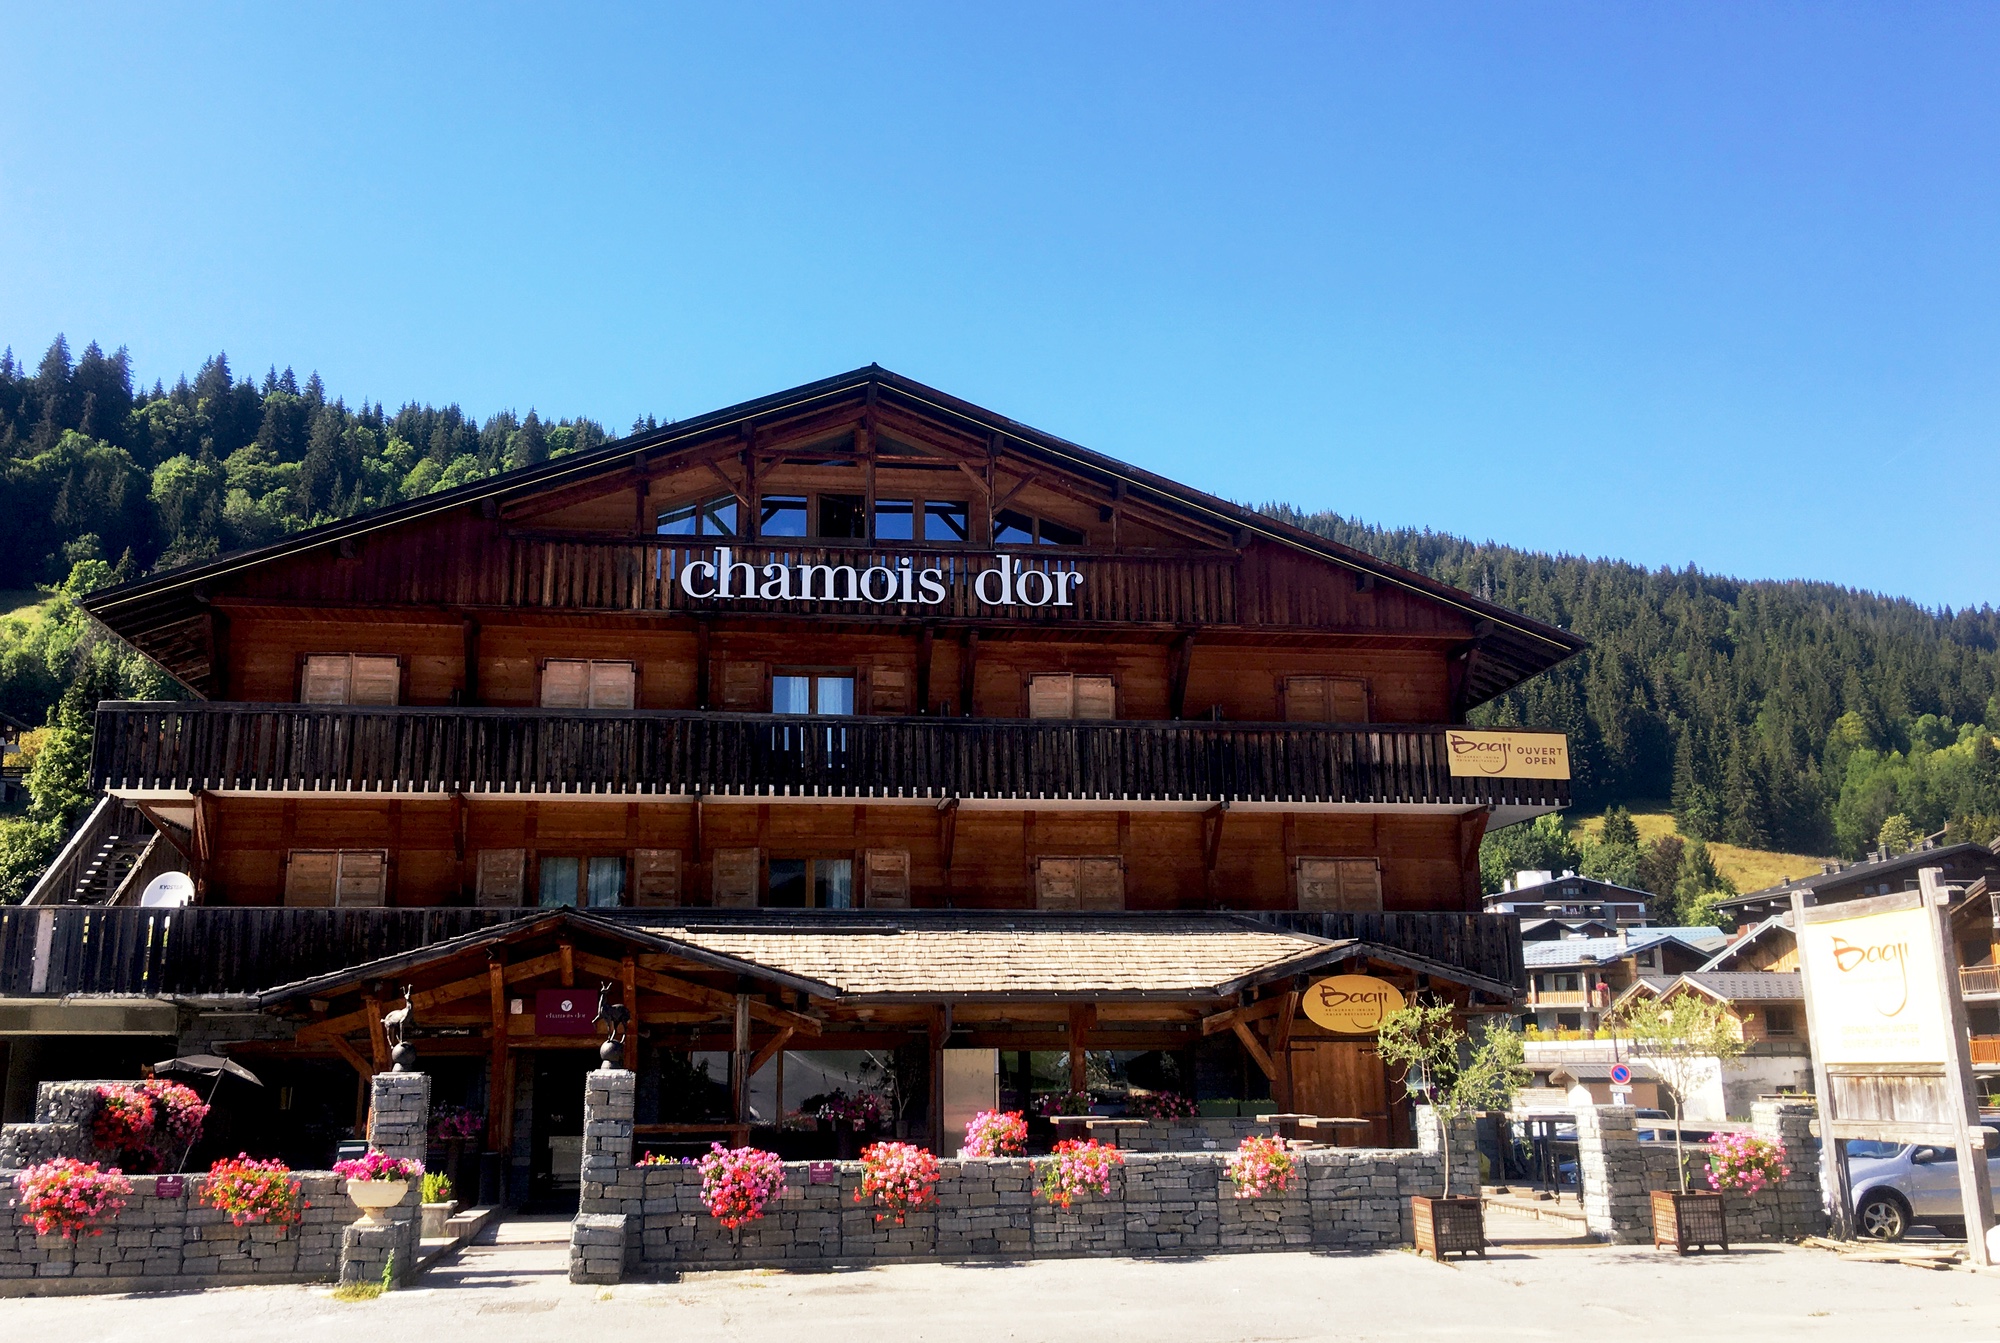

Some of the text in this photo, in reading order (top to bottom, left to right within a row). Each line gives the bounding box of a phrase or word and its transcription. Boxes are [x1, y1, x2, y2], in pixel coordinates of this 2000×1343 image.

[680, 546, 1083, 606] chamois d'or
[1450, 734, 1511, 774] Baaji
[1516, 746, 1563, 756] OUVERT
[1525, 757, 1556, 765] OPEN
[1831, 934, 1909, 1017] Baaji
[1319, 984, 1389, 1029] Baaji
